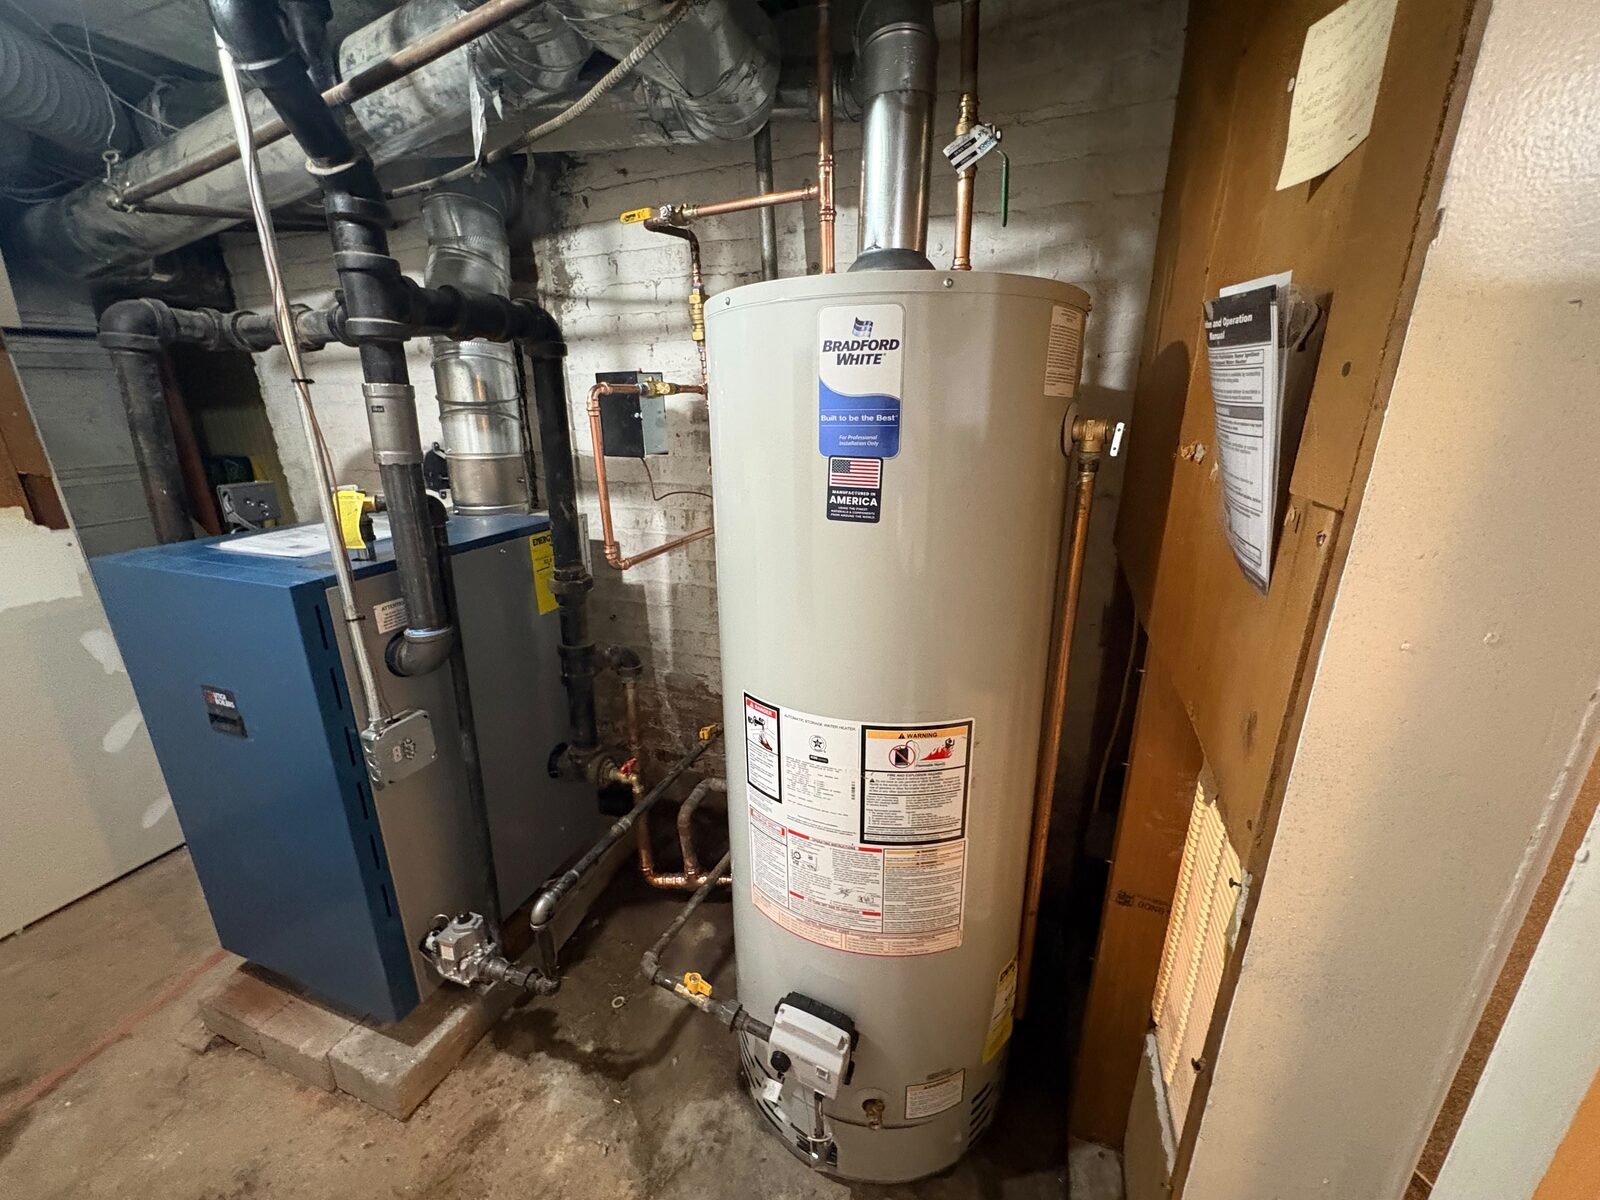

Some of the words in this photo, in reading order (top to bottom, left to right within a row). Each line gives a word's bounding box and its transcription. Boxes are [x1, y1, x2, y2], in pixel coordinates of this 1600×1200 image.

[1223, 313, 1253, 327] Operation
[822, 339, 900, 352] BRADFORD
[836, 353, 883, 365] WHITE
[829, 495, 878, 506] AMERICA
